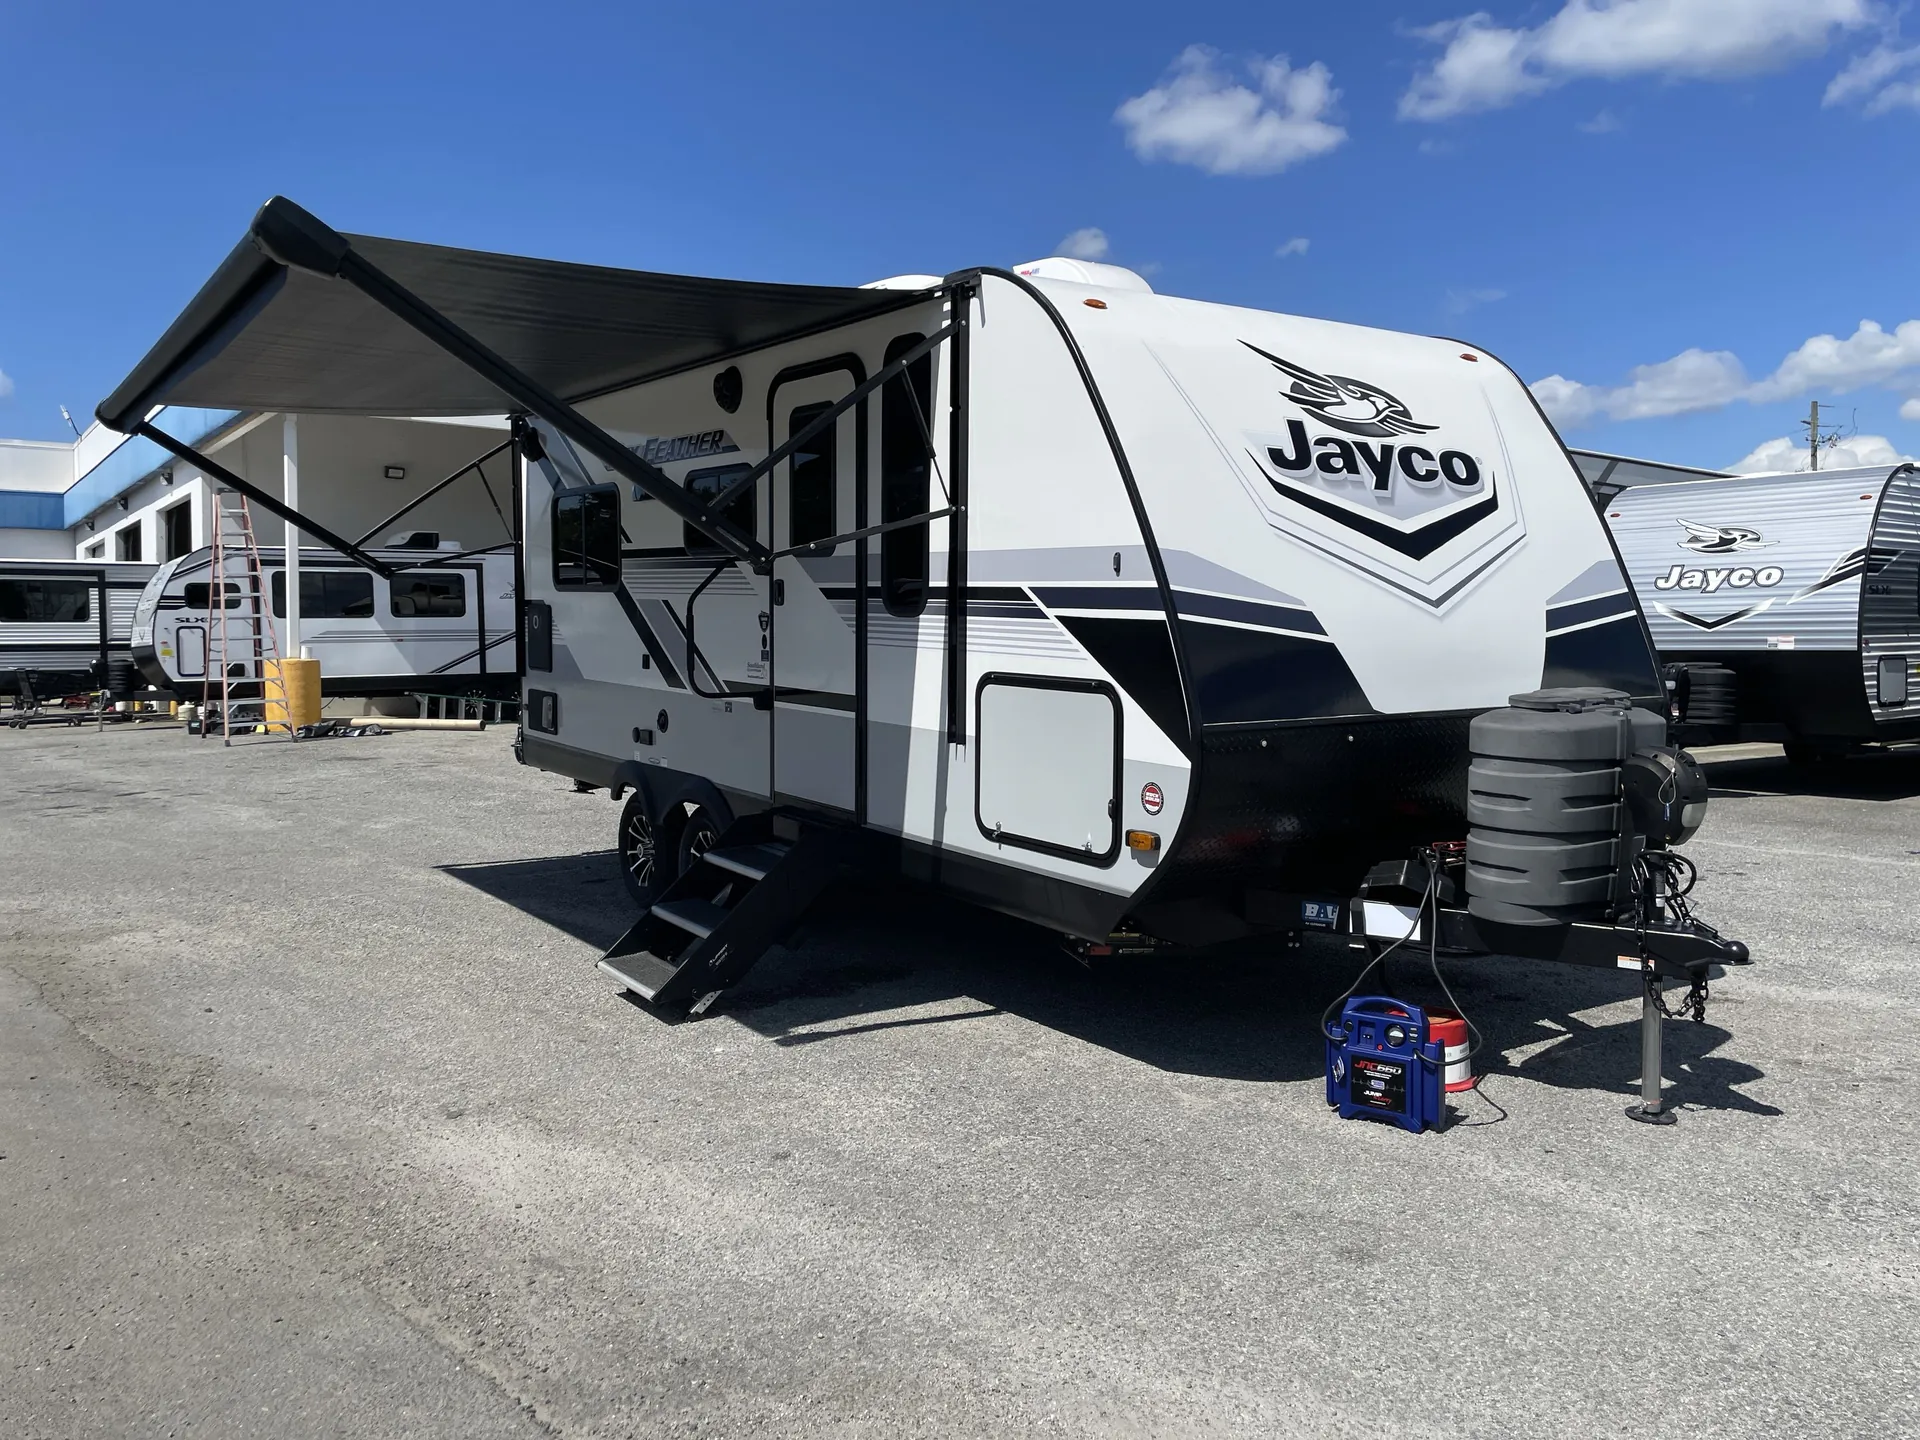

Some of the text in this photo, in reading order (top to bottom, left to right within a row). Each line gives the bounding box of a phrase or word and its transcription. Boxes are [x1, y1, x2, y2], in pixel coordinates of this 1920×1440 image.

[645, 429, 724, 464] FEATHER
[1265, 417, 1484, 497] Jayco
[1654, 564, 1784, 593] Jayco
